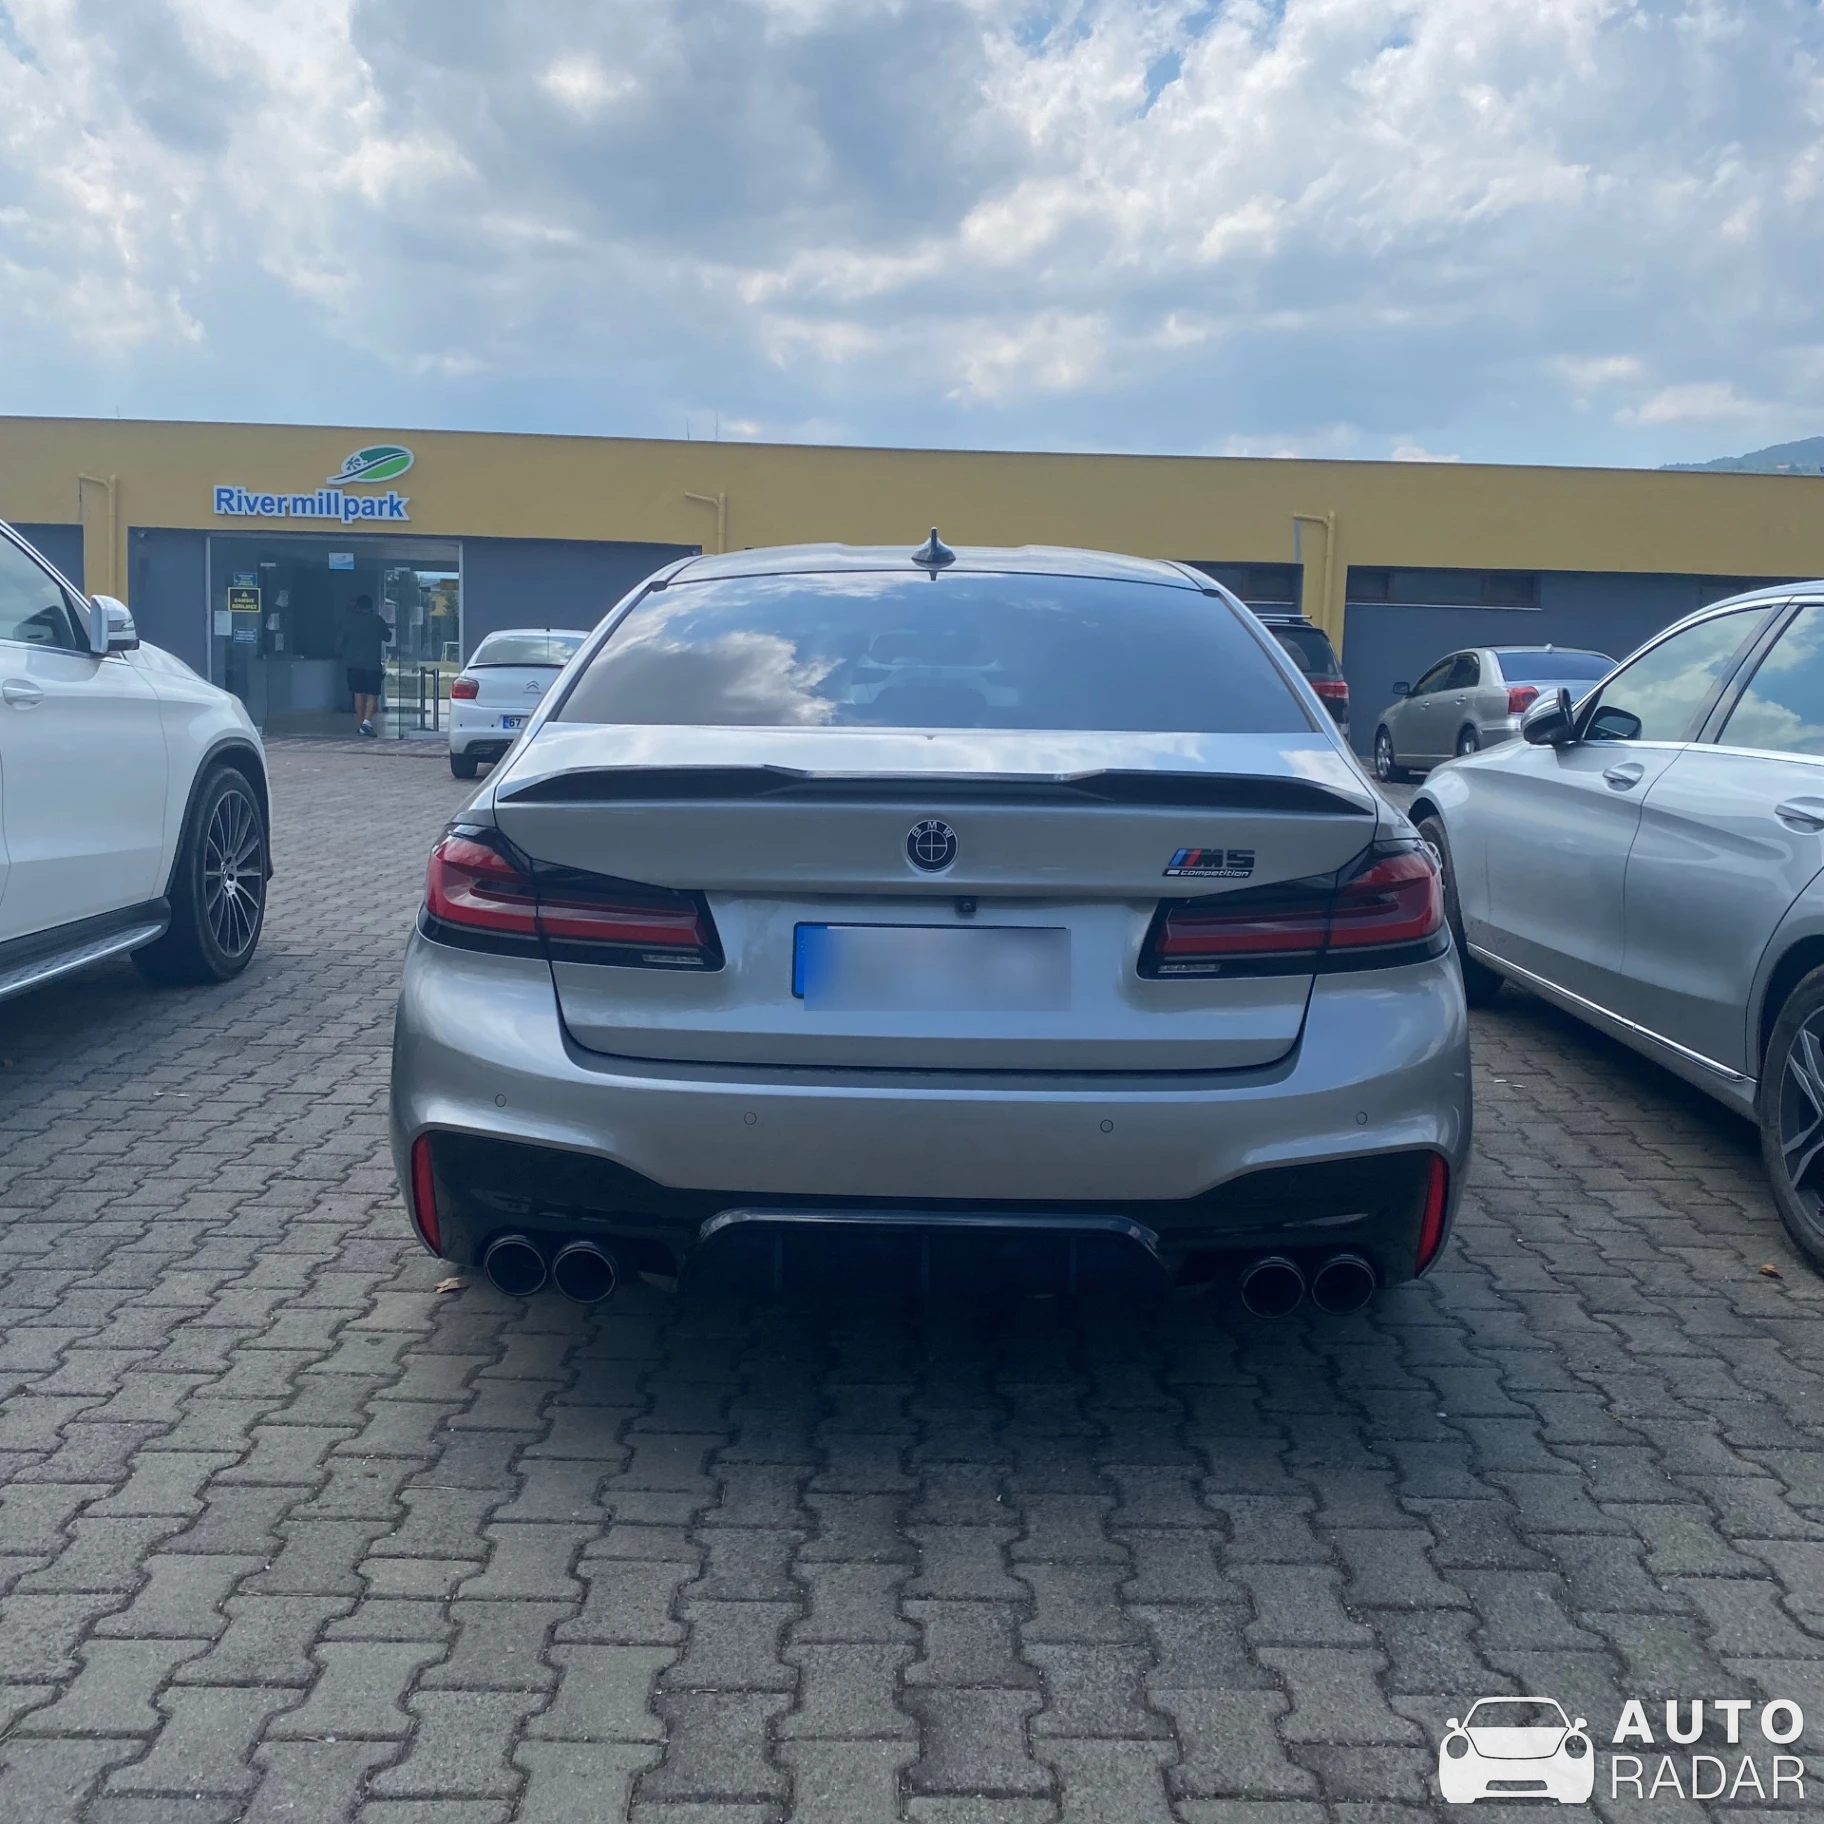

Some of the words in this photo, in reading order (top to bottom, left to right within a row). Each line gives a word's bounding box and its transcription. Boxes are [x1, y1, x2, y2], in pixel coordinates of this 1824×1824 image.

[215, 487, 405, 521] Rivermillpark
[508, 718, 521, 727] 67
[911, 821, 954, 838] BMW
[1190, 849, 1255, 868] M5
[1180, 869, 1250, 878] competition
